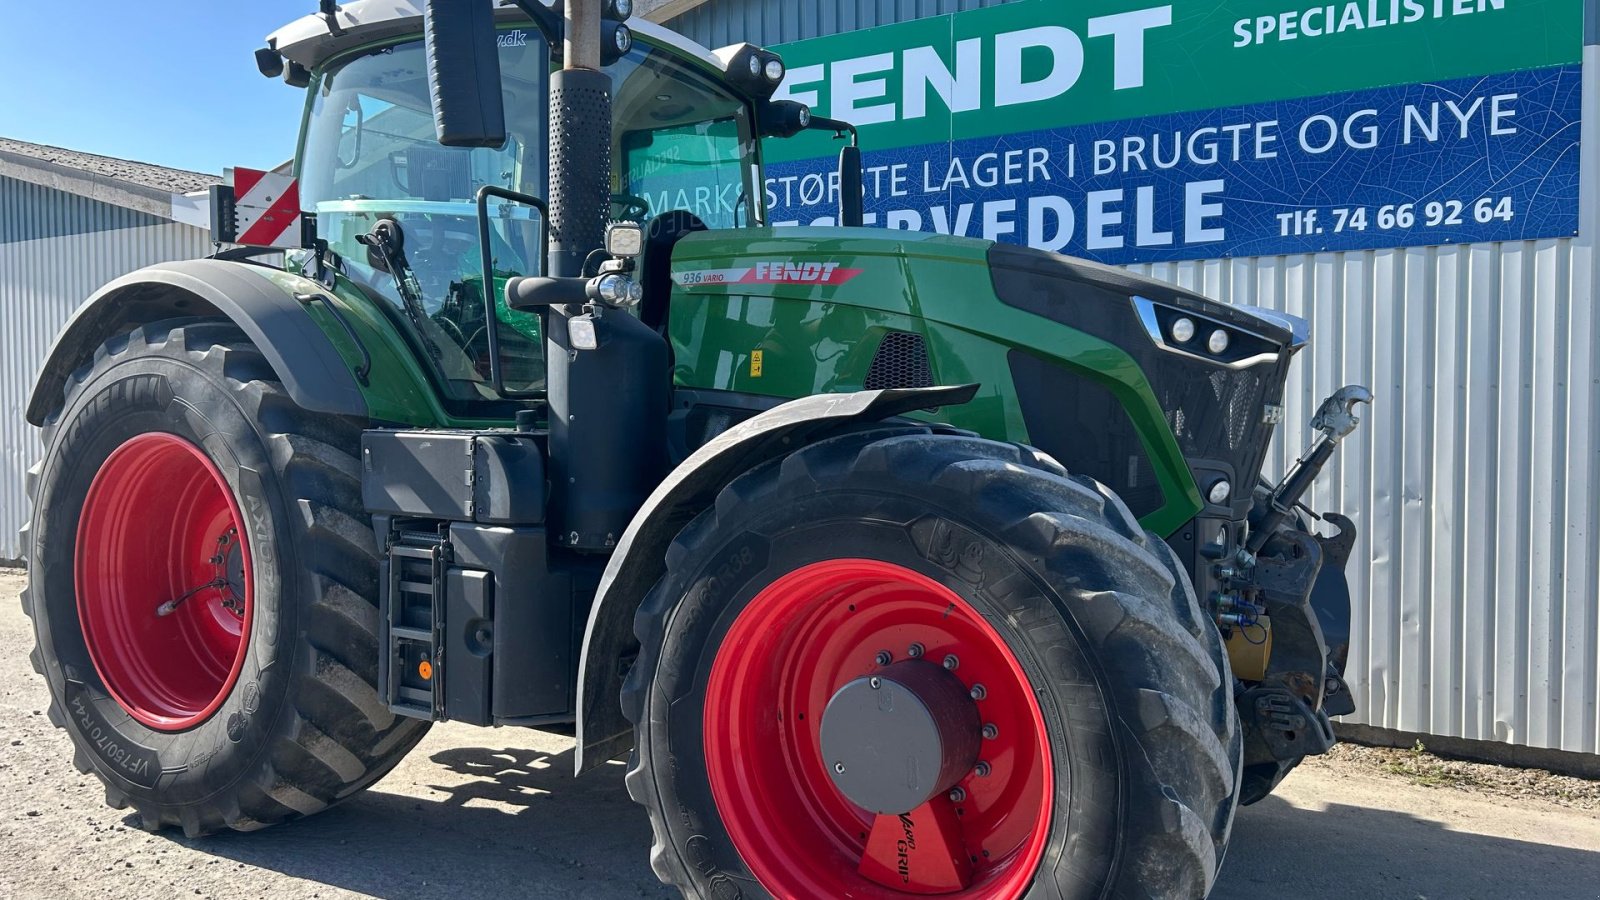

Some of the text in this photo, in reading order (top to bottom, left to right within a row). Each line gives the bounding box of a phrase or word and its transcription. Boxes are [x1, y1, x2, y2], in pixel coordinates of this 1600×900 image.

[769, 5, 1172, 126] FENDT
[765, 163, 908, 210] STØRTE
[924, 147, 1051, 193] LAGER
[1068, 144, 1075, 179] I
[1094, 120, 1278, 176] BRUGTE
[1299, 109, 1379, 154] OG
[1403, 93, 1518, 145] NYE
[1276, 196, 1514, 237] Tlf. 74 66 92 64
[683, 273, 724, 284] 936 VARIO
[756, 262, 840, 281] FENDT
[72, 696, 94, 726] R44
[897, 840, 910, 884] GRIP
